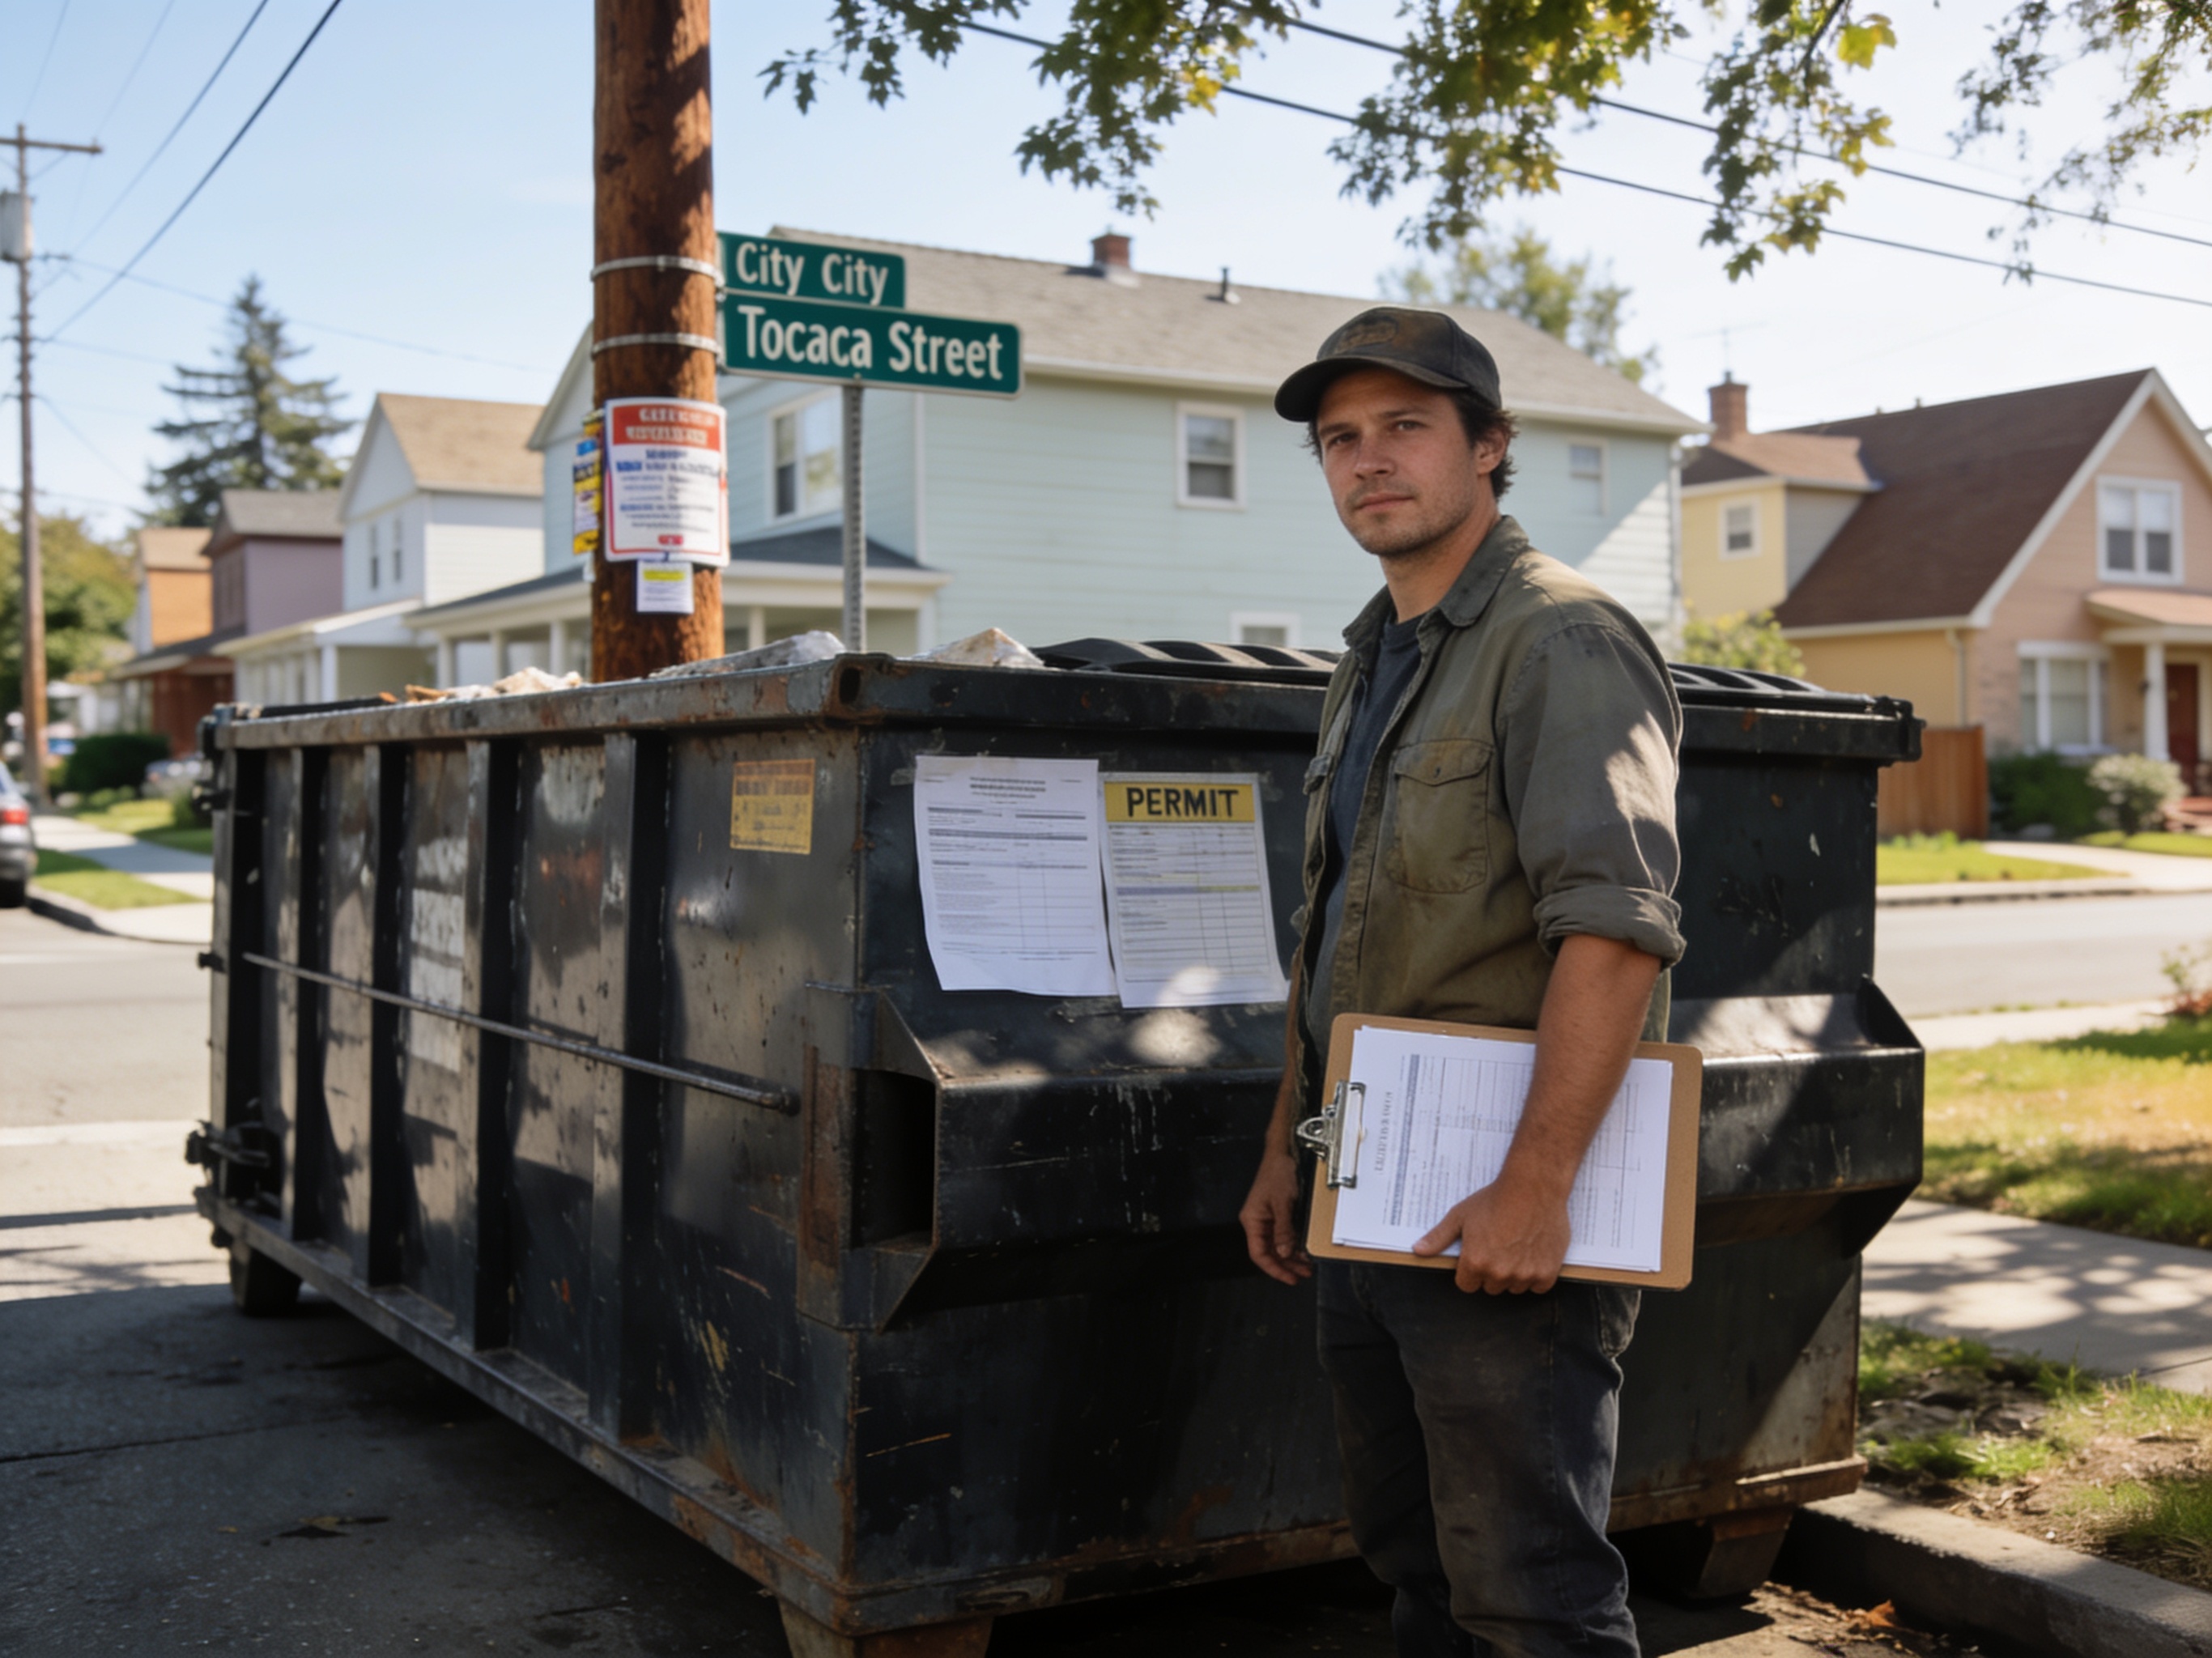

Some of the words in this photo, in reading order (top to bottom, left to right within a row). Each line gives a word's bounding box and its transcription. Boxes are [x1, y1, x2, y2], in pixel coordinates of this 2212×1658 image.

[736, 242, 805, 296] City
[822, 253, 889, 306] City
[737, 305, 872, 368] Tocaca
[889, 321, 1003, 380] Street
[1127, 788, 1239, 817] PERMIT
